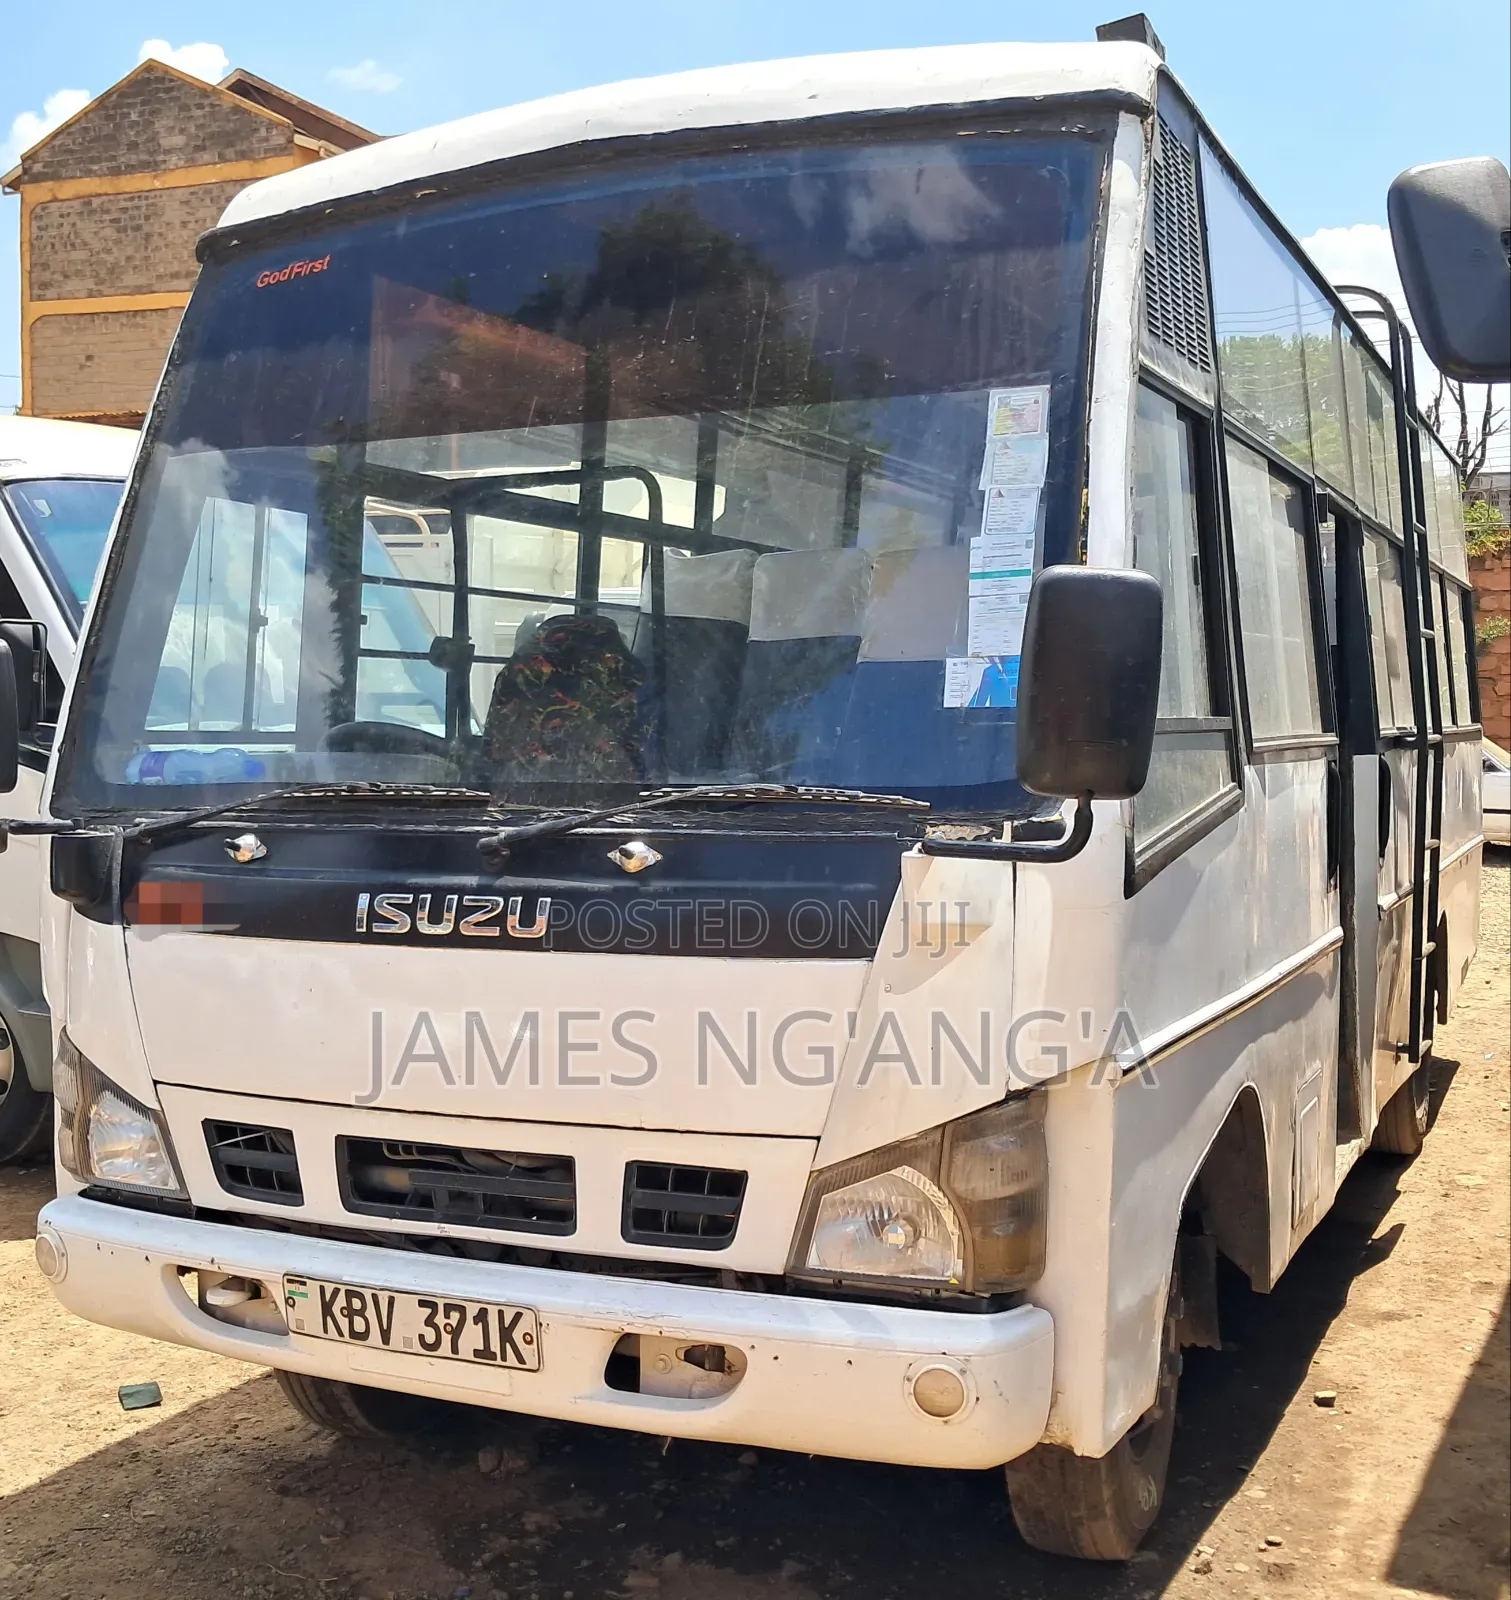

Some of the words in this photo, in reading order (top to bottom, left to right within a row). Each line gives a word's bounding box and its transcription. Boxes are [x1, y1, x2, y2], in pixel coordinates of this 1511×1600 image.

[256, 263, 292, 288] God
[290, 254, 331, 279] First
[355, 892, 551, 938] ISUZU
[319, 1284, 396, 1346] KBV
[417, 1298, 527, 1366] 371K
